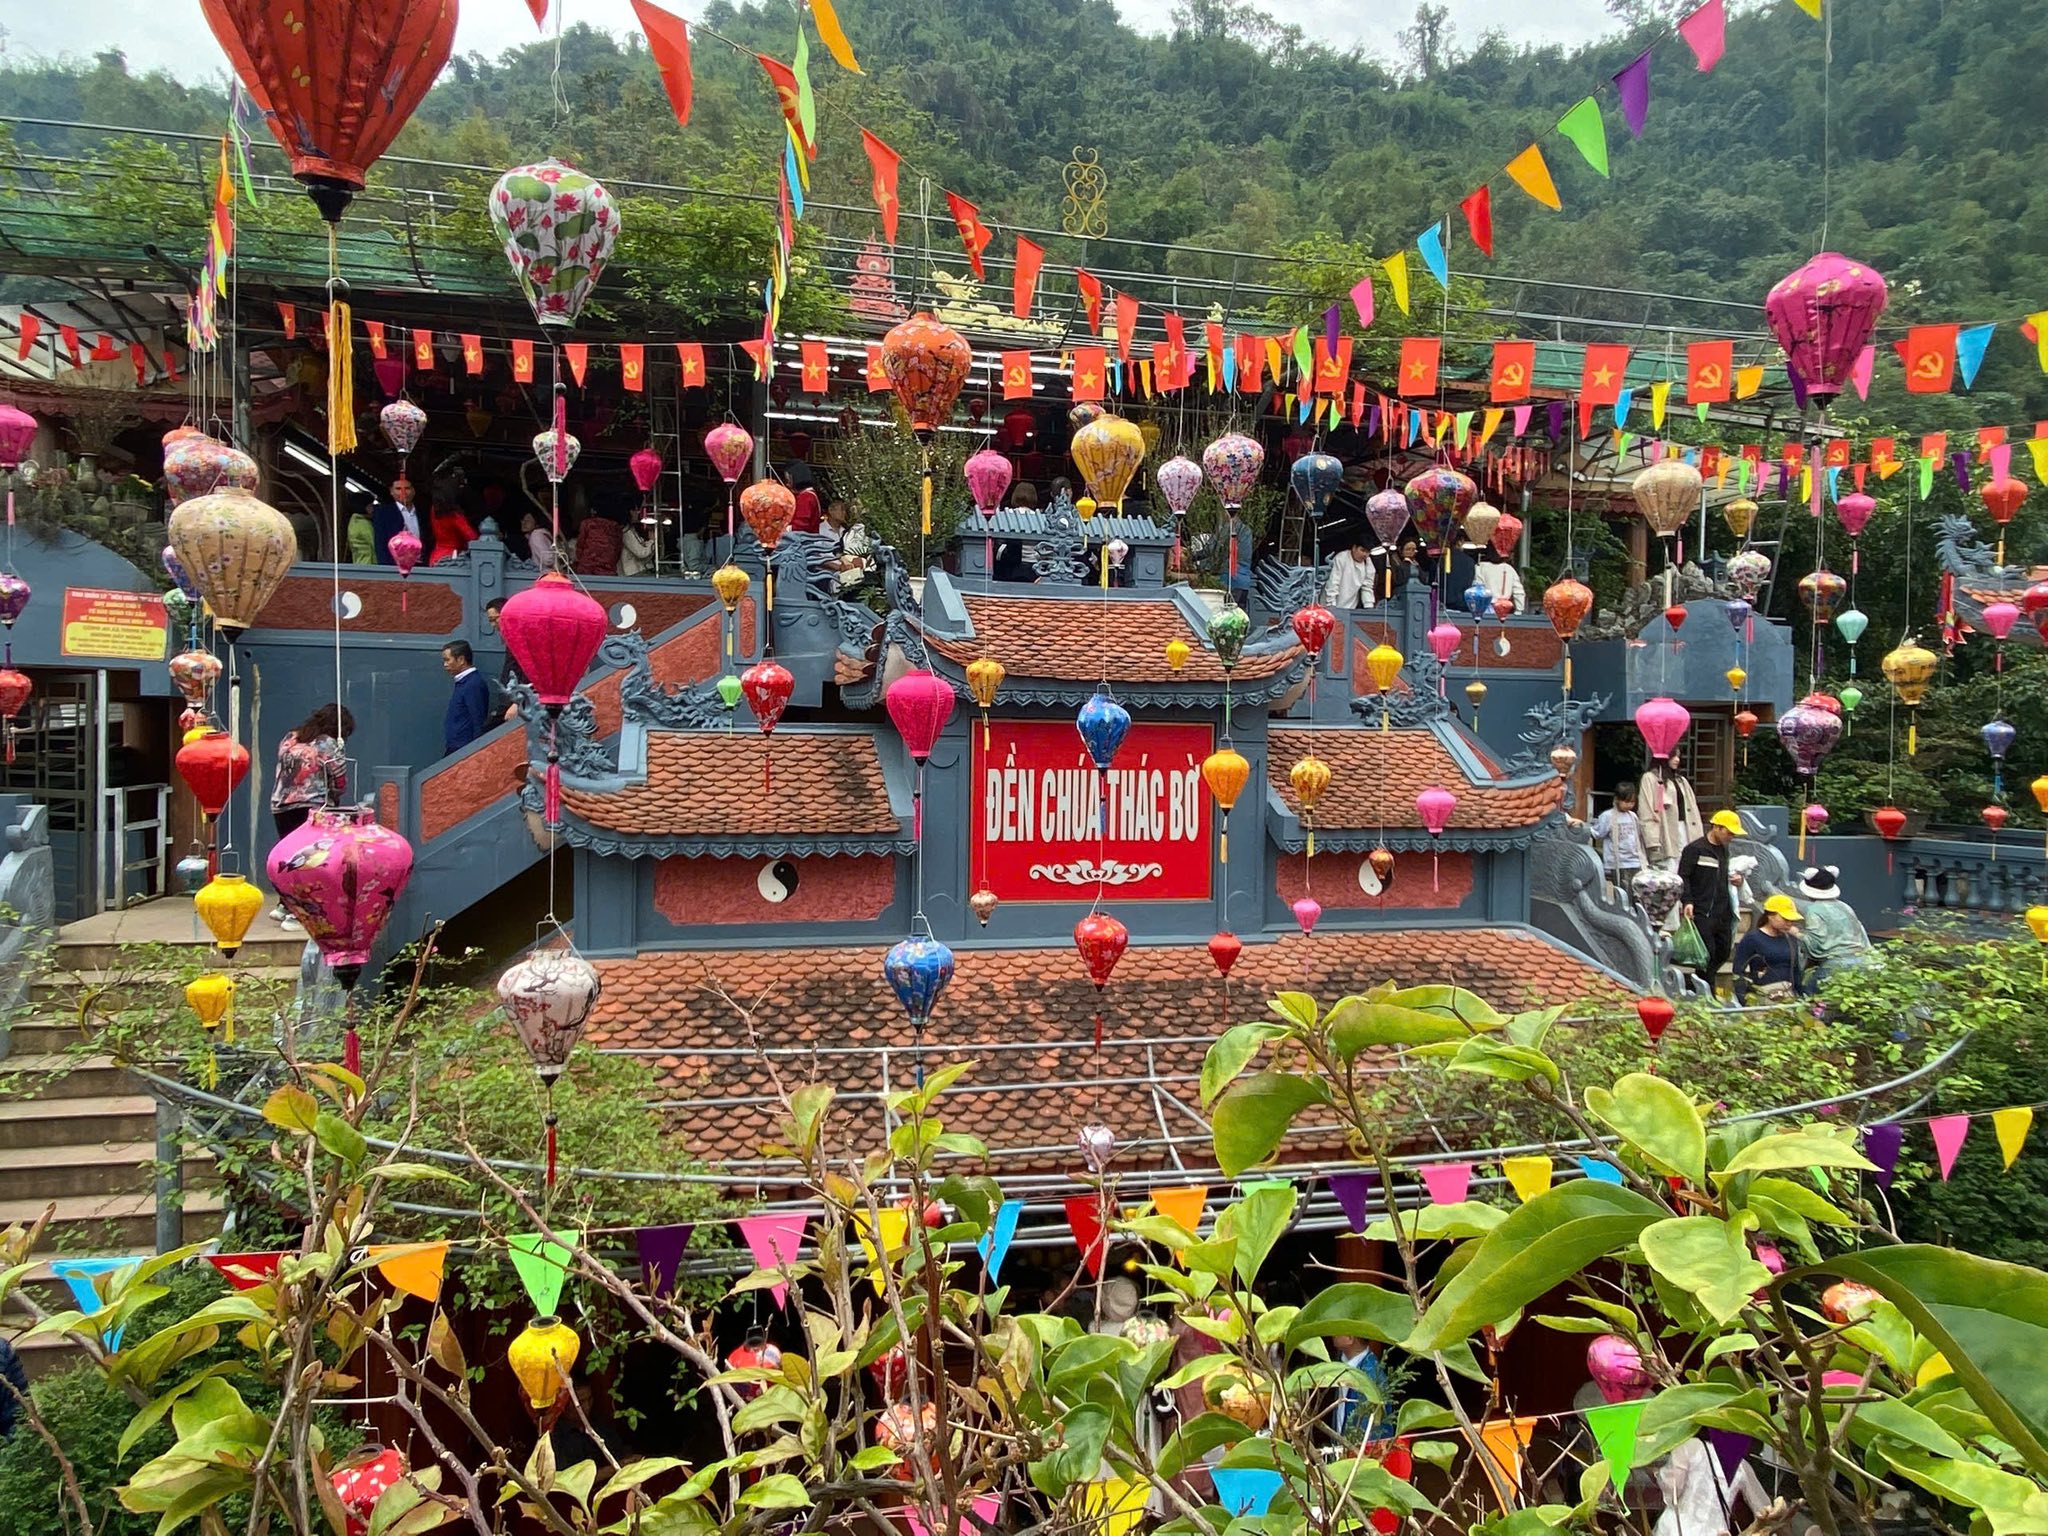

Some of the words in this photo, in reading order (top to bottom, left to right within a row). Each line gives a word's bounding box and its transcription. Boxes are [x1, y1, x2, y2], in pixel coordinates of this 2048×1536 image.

[986, 742, 1035, 842] ĐỀN
[1040, 753, 1101, 843] CHÚA
[1107, 753, 1165, 842] THÁC
[1169, 753, 1201, 842] BỜ
